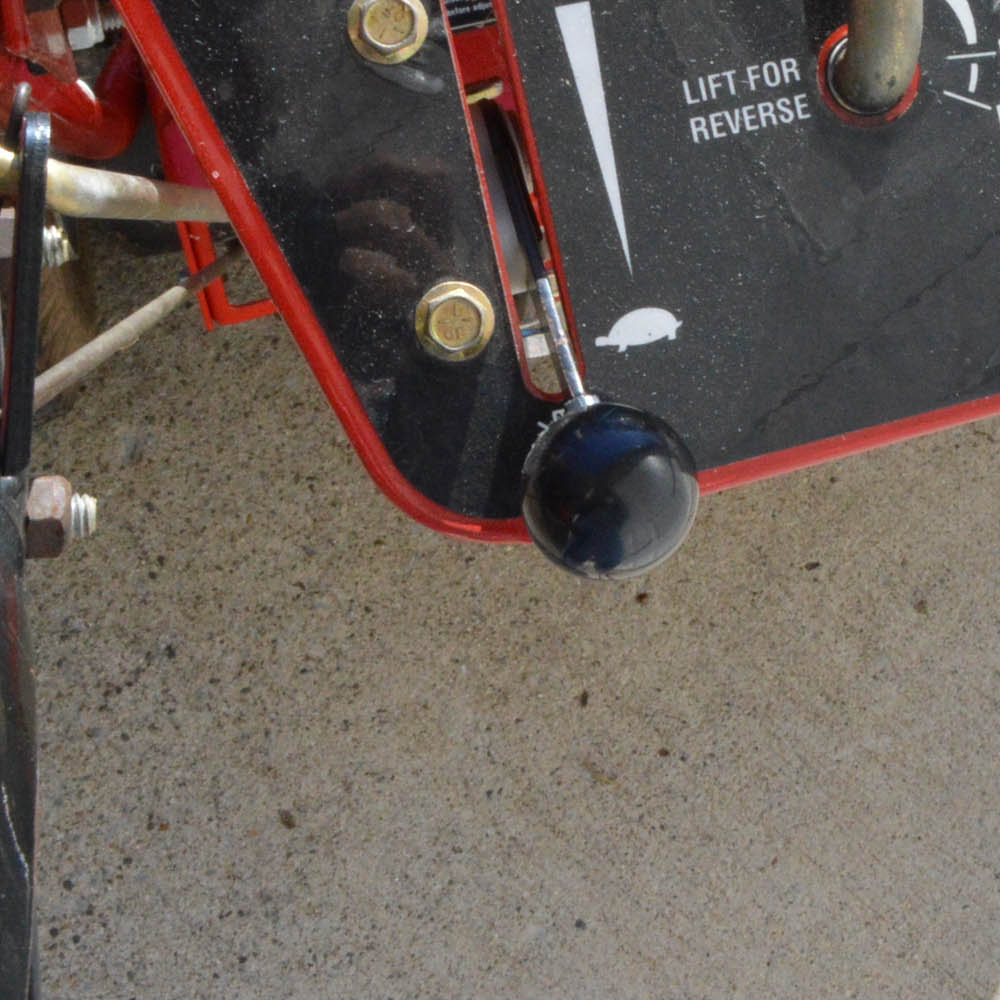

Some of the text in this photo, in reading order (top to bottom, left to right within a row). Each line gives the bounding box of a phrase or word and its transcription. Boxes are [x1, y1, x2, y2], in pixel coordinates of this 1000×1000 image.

[681, 57, 801, 105] LIFT FOR
[689, 93, 812, 144] REVERSE
